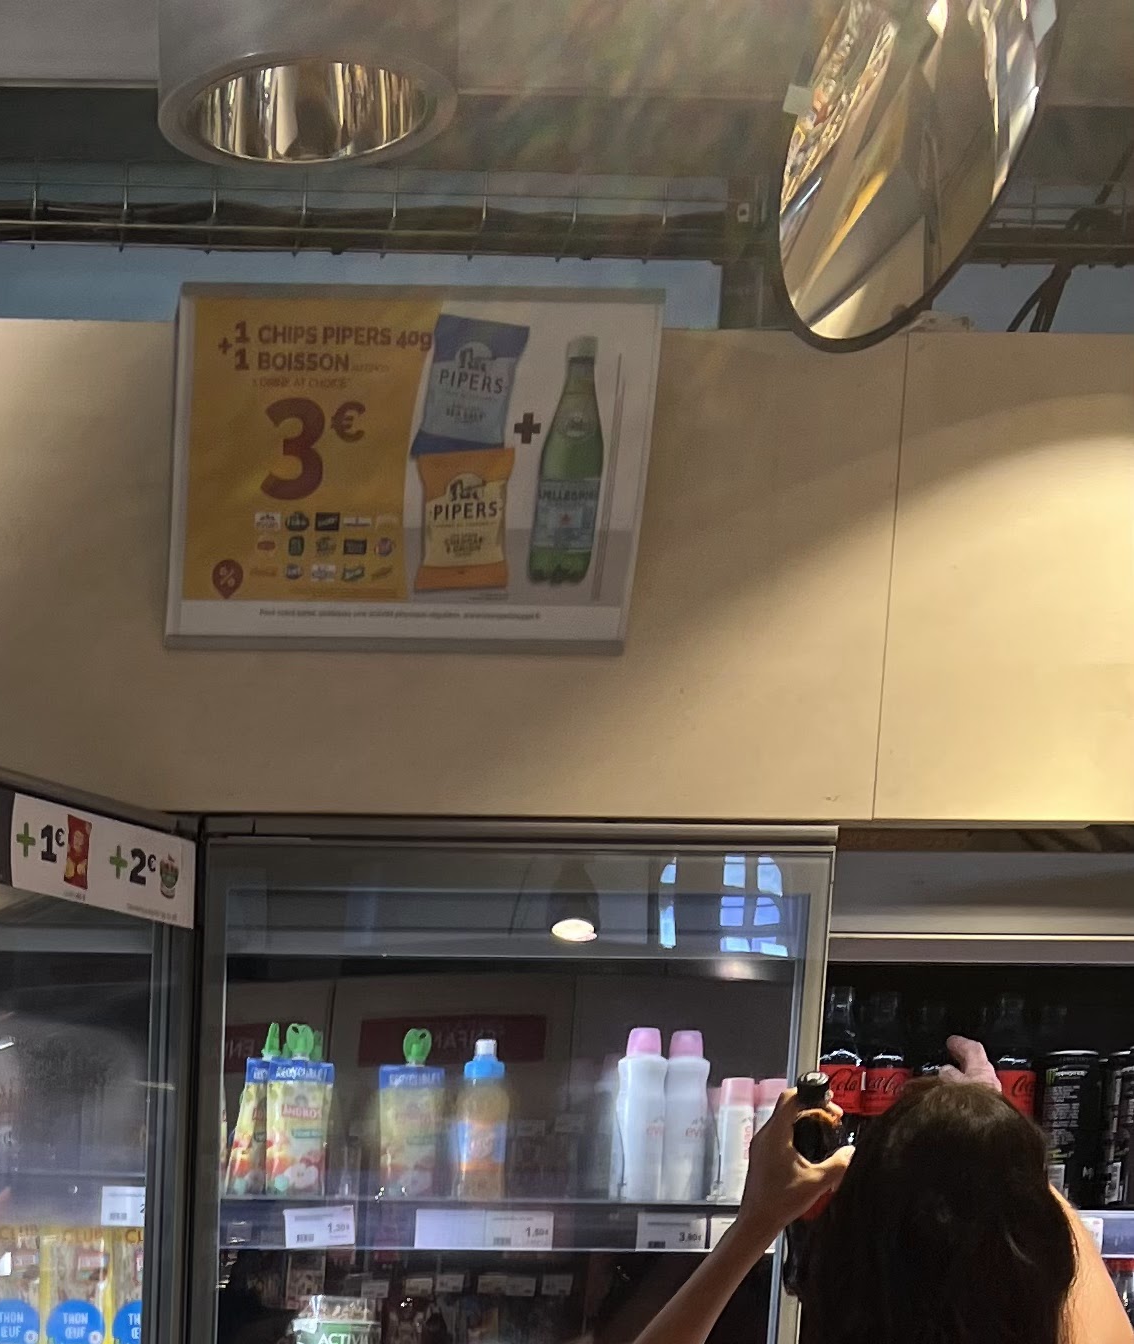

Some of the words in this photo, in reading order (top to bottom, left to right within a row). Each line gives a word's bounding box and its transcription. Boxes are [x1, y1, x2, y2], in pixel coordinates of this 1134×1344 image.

[258, 325, 318, 345] CHIPS
[322, 326, 392, 346] PIPERS
[396, 331, 433, 351] 40g
[257, 351, 350, 372] BOISSON
[439, 368, 504, 394] PIPERS
[433, 501, 498, 521] PIPERS
[125, 1228, 144, 1244] CL
[63, 1312, 88, 1325] THON
